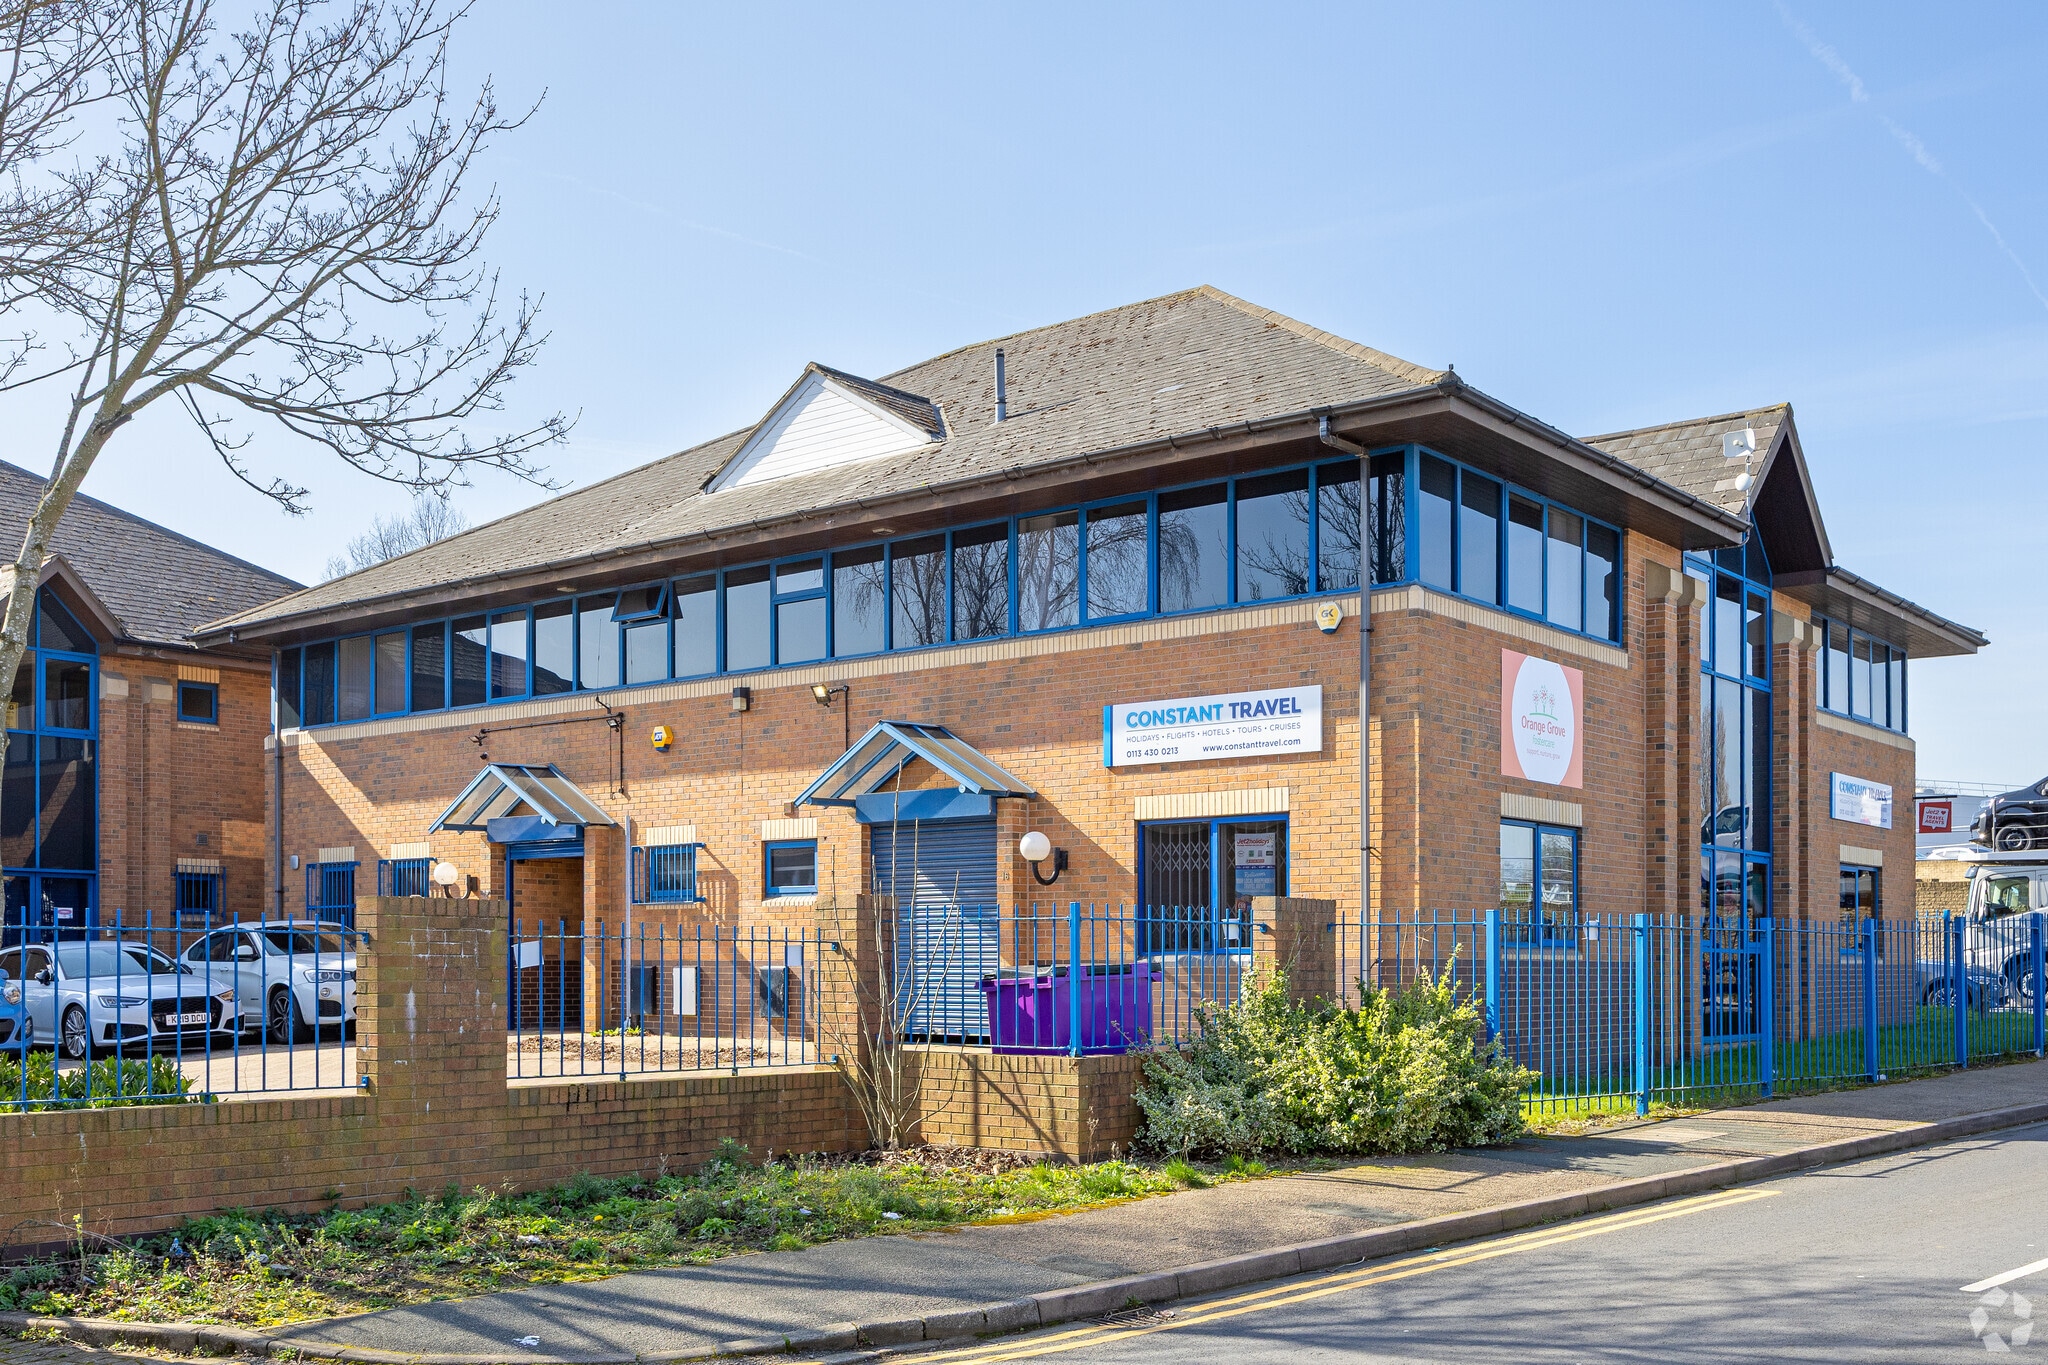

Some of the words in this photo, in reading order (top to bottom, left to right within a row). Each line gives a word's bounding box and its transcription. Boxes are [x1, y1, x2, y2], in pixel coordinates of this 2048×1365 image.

[1321, 608, 1334, 618] GK
[1126, 703, 1224, 728] CONSTANT
[1228, 697, 1302, 719] TRAVEL
[1126, 734, 1160, 743] HOLIDAYS
[1166, 731, 1195, 740] FLIGHTS
[1202, 728, 1230, 737] HOTELS
[1238, 725, 1262, 734] TOURS
[1269, 722, 1301, 731] CRUISES
[1521, 715, 1546, 735] Orange
[1547, 721, 1566, 737] Grove
[1126, 750, 1142, 758] 0113
[1144, 748, 1159, 757] 430
[1161, 747, 1179, 756] 0213
[1203, 738, 1301, 752] www.constanttravel.com
[1839, 780, 1867, 796] CONSTANT
[171, 1015, 190, 1024] K19
[191, 1014, 206, 1022] DCU
